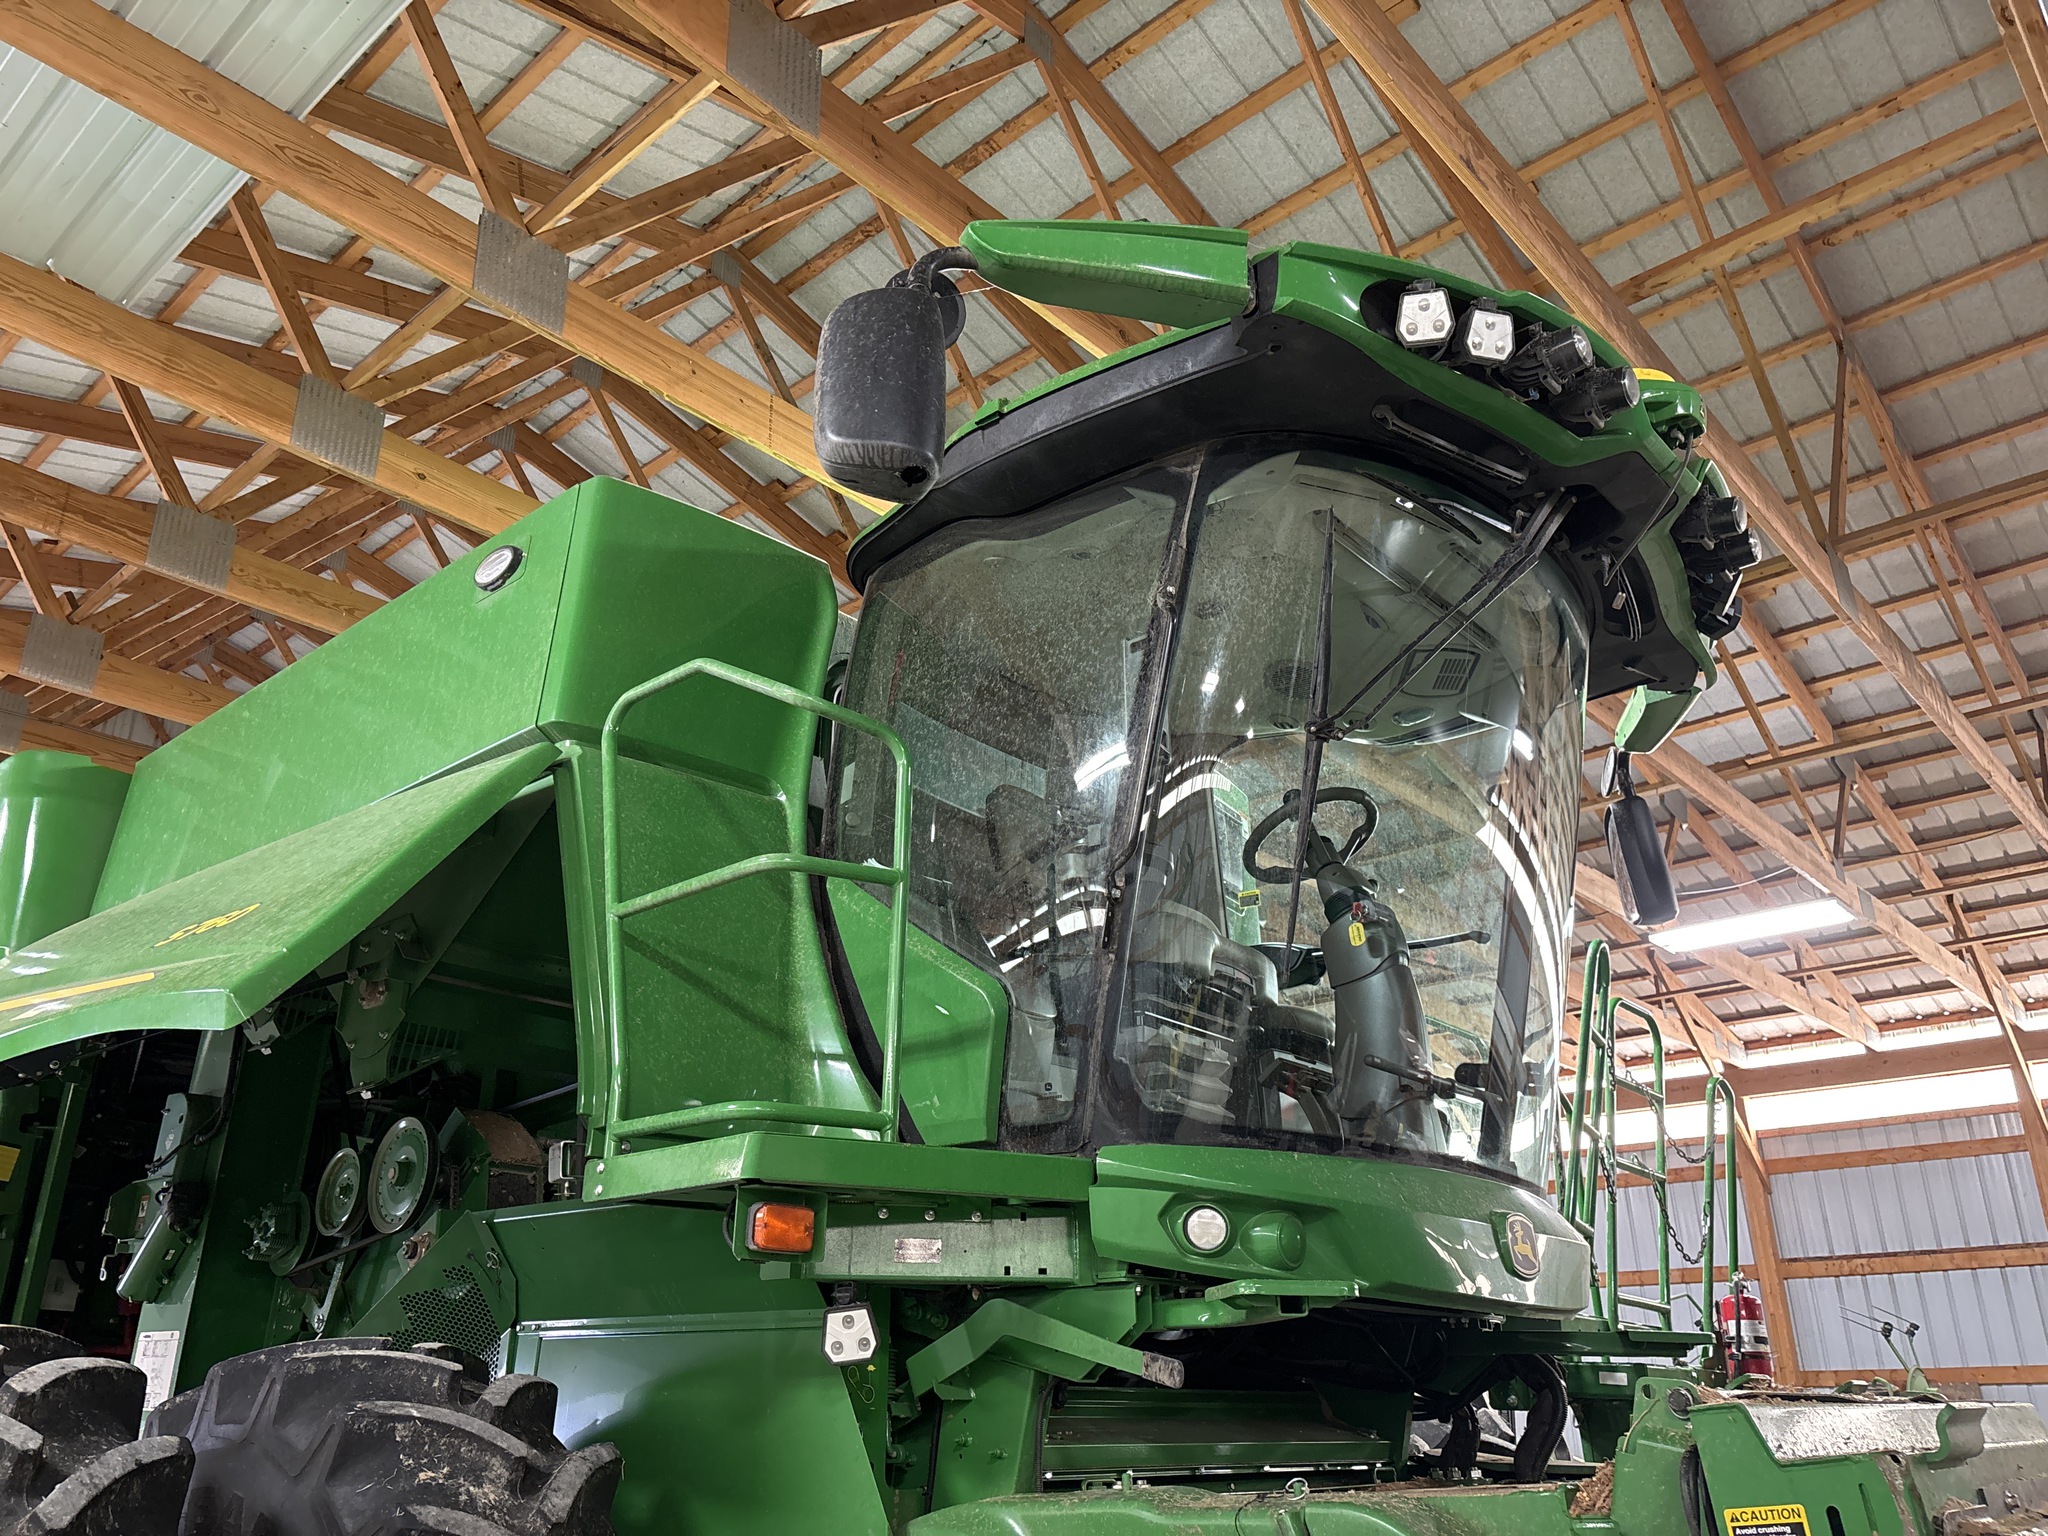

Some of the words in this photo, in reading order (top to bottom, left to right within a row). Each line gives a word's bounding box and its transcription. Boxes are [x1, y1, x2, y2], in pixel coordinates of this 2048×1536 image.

[1740, 1508, 1802, 1523] CAUTION
[1735, 1526, 1757, 1535] Avoid
[1758, 1525, 1791, 1534] crushing
